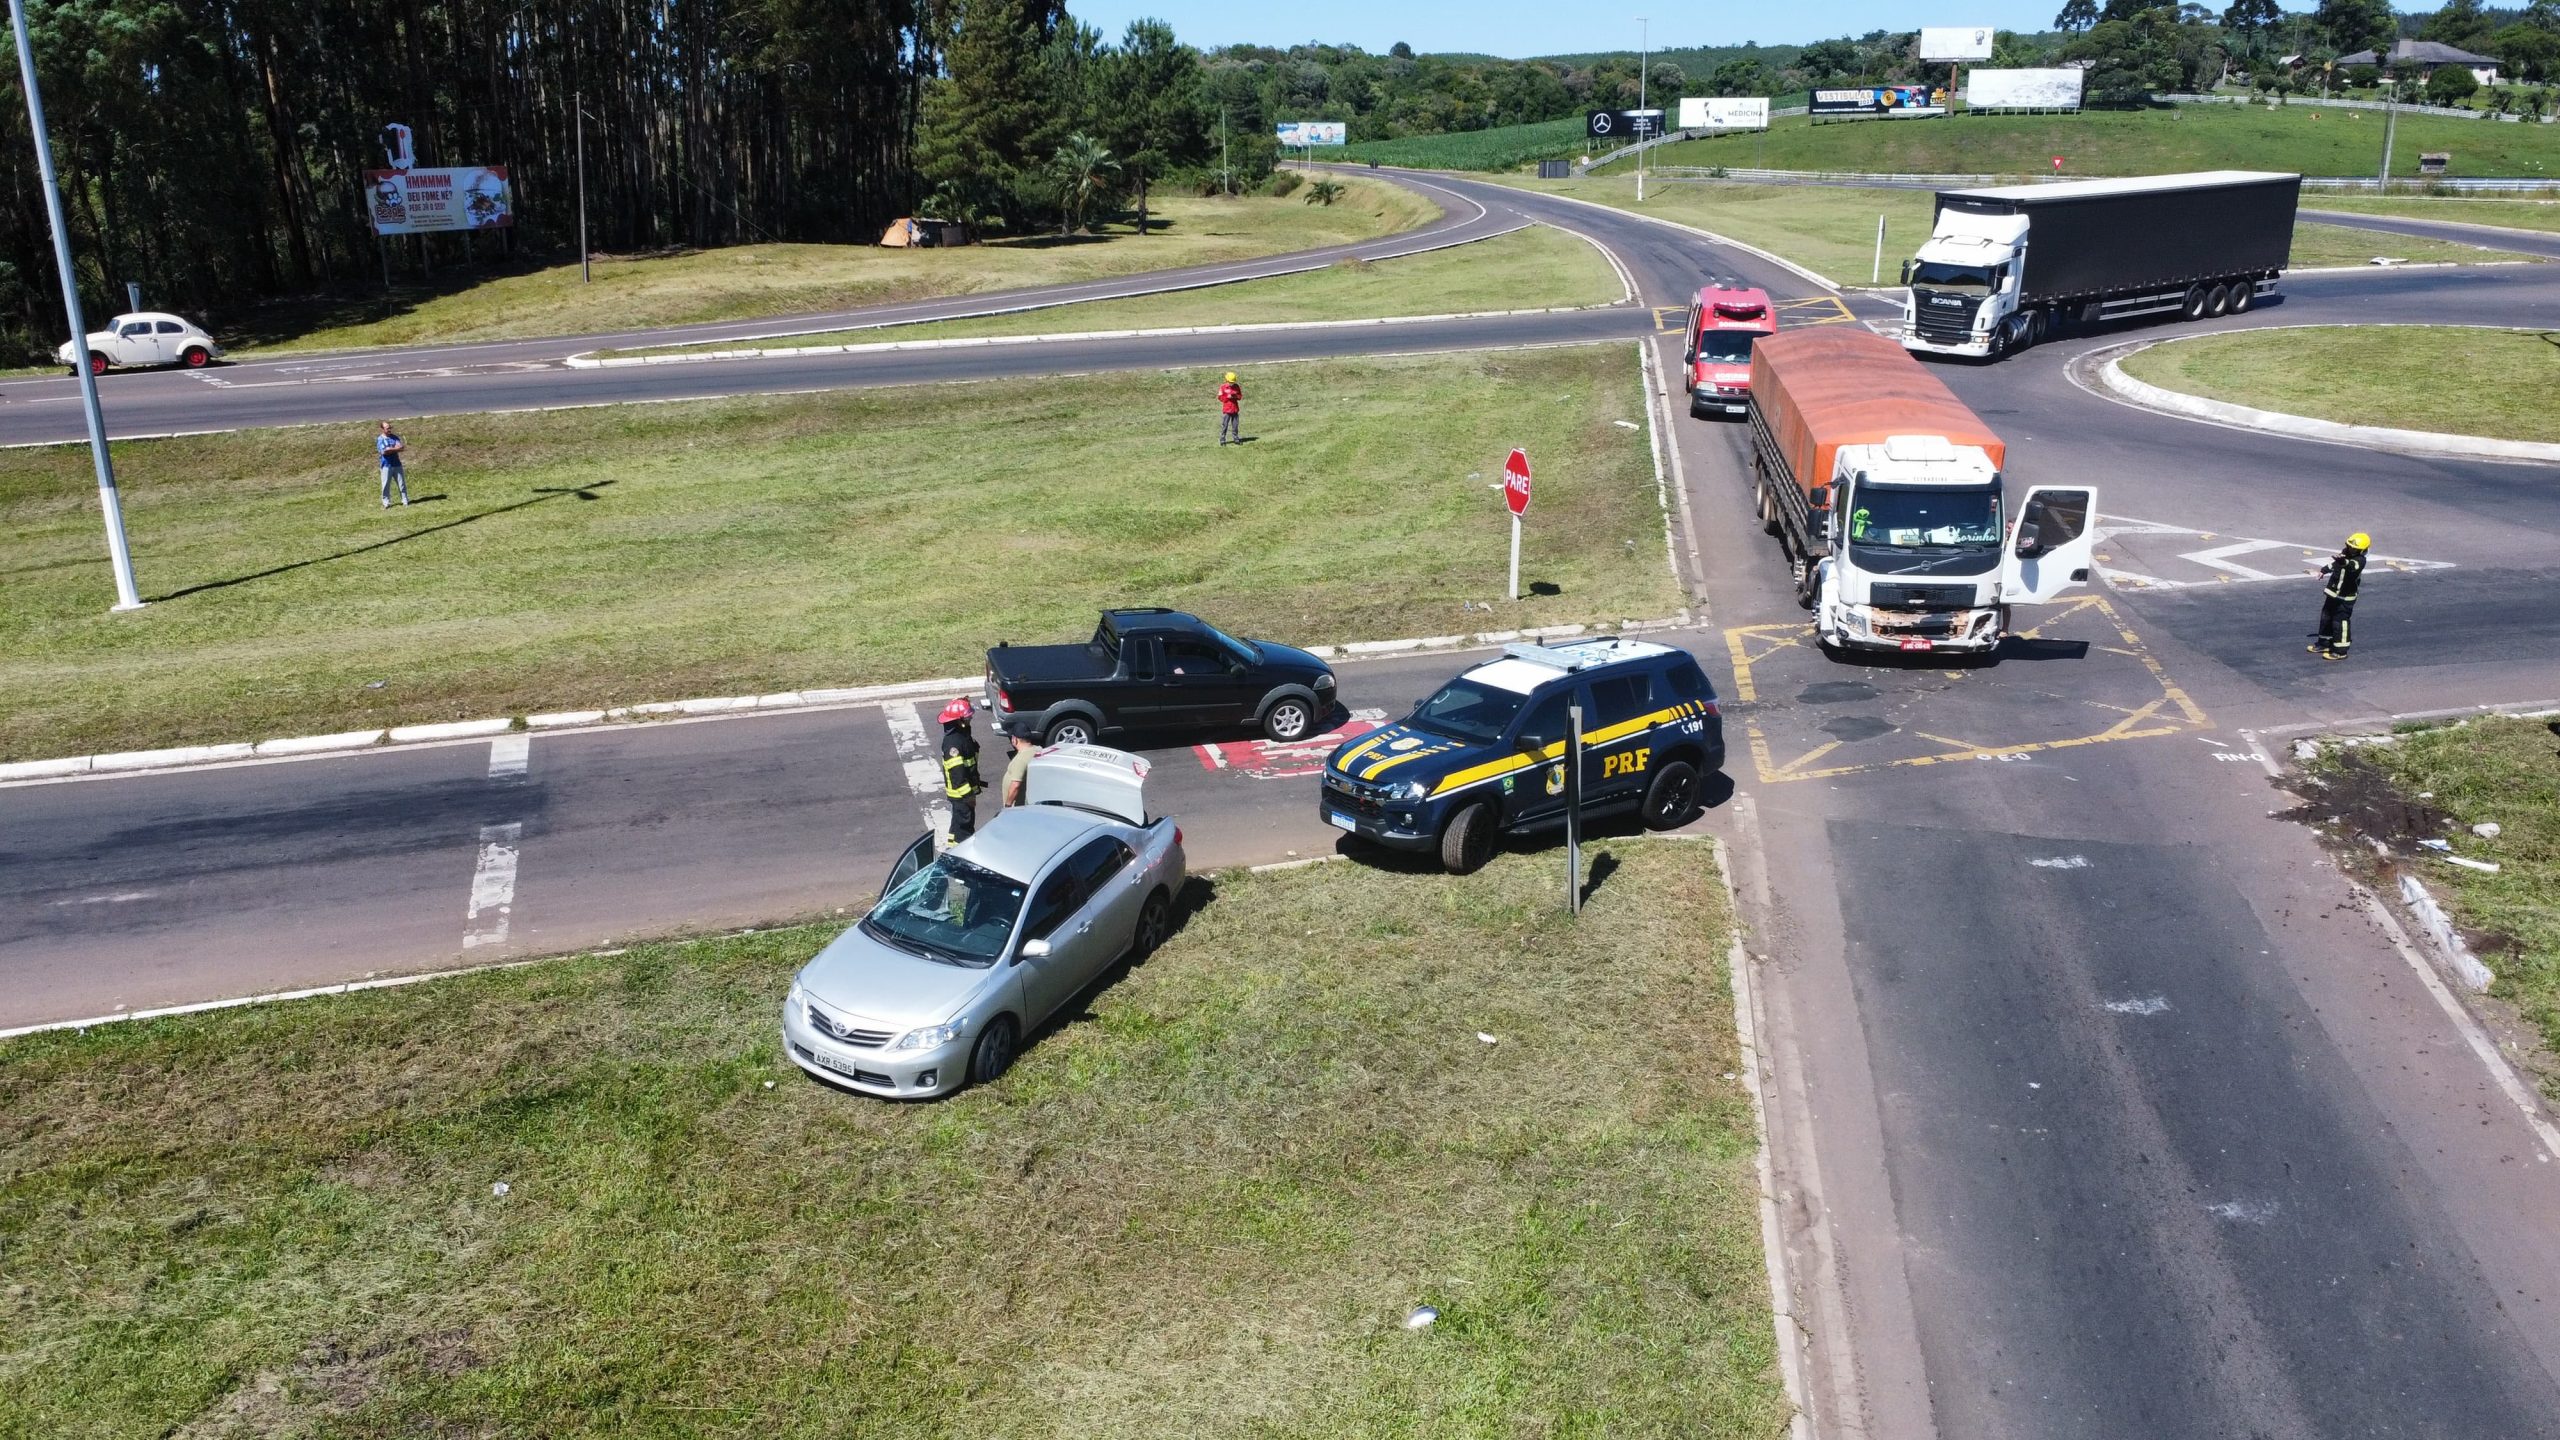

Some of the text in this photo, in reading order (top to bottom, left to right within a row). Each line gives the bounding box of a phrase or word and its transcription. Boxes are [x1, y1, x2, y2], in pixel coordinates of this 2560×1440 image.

[1817, 91, 1873, 101] VESTIBULAR
[407, 191, 421, 202] DEU
[422, 190, 440, 202] FOME
[1931, 296, 1963, 307] SCANIA
[1505, 469, 1529, 495] PARE
[1687, 719, 1703, 734] 191
[1363, 750, 1388, 761] PRF
[1603, 748, 1651, 779] PRF
